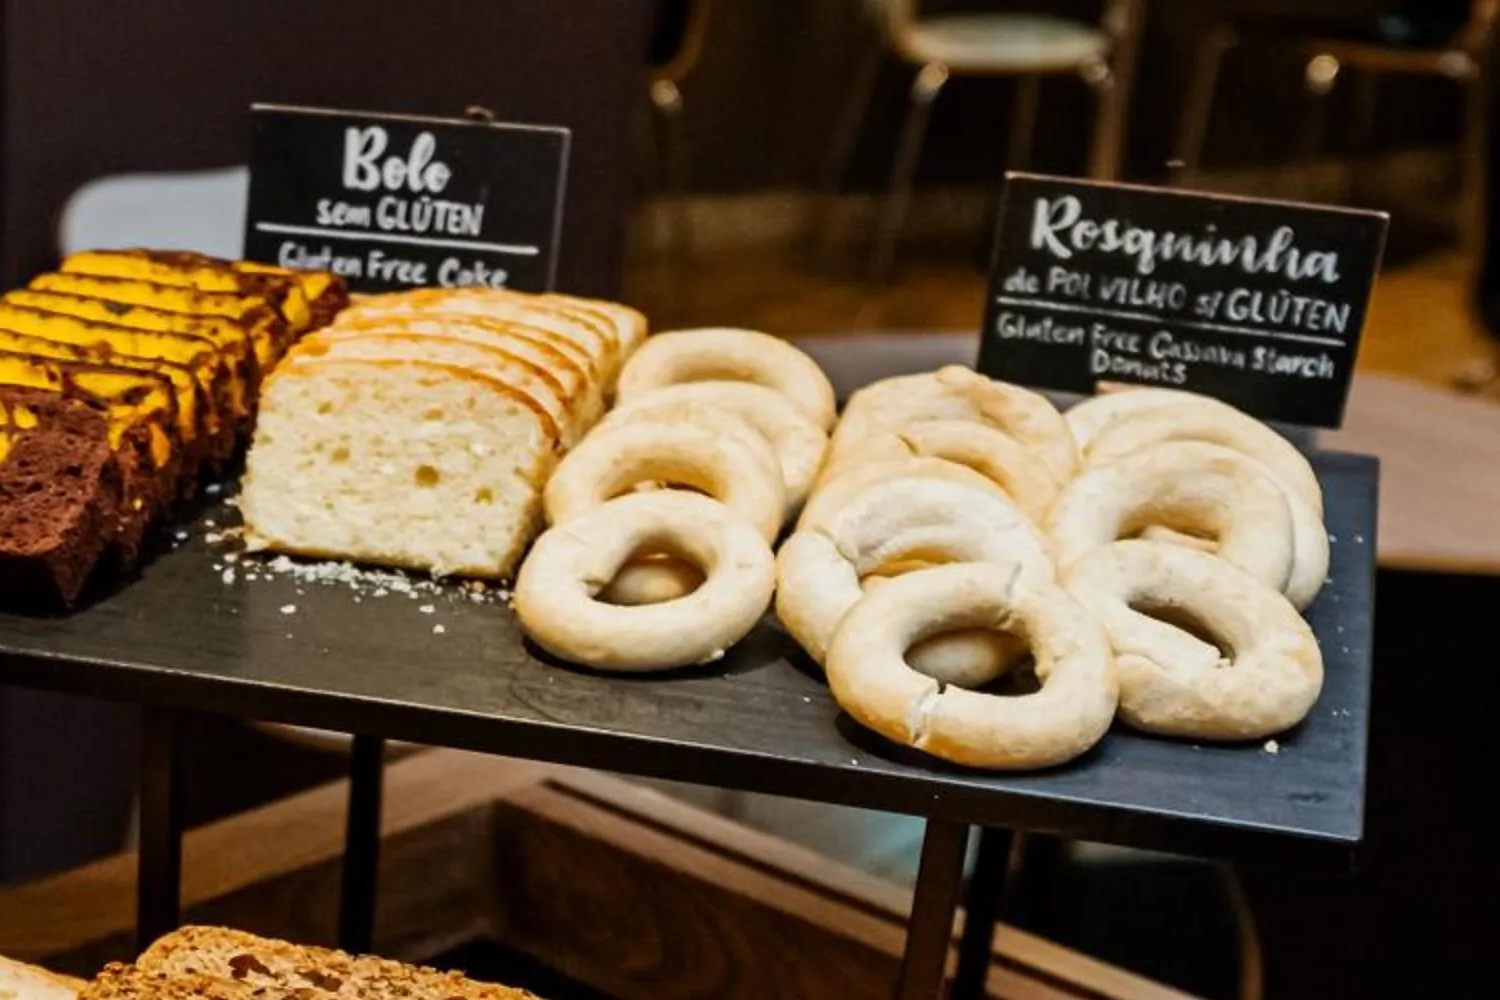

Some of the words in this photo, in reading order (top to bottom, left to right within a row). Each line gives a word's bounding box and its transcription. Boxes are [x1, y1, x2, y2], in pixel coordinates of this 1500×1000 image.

[343, 126, 451, 193] Bolo
[316, 199, 370, 228] sem
[375, 196, 484, 236] GLÚTEN
[1029, 194, 1341, 284] Rosquinha
[278, 241, 362, 278] Gluten
[367, 250, 427, 285] Free
[437, 257, 508, 289] Cake
[1003, 267, 1040, 294] de
[997, 312, 1086, 346] Gluten
[1091, 322, 1141, 353] Free
[1252, 345, 1336, 380] Starch
[1091, 348, 1188, 385] Donuts
